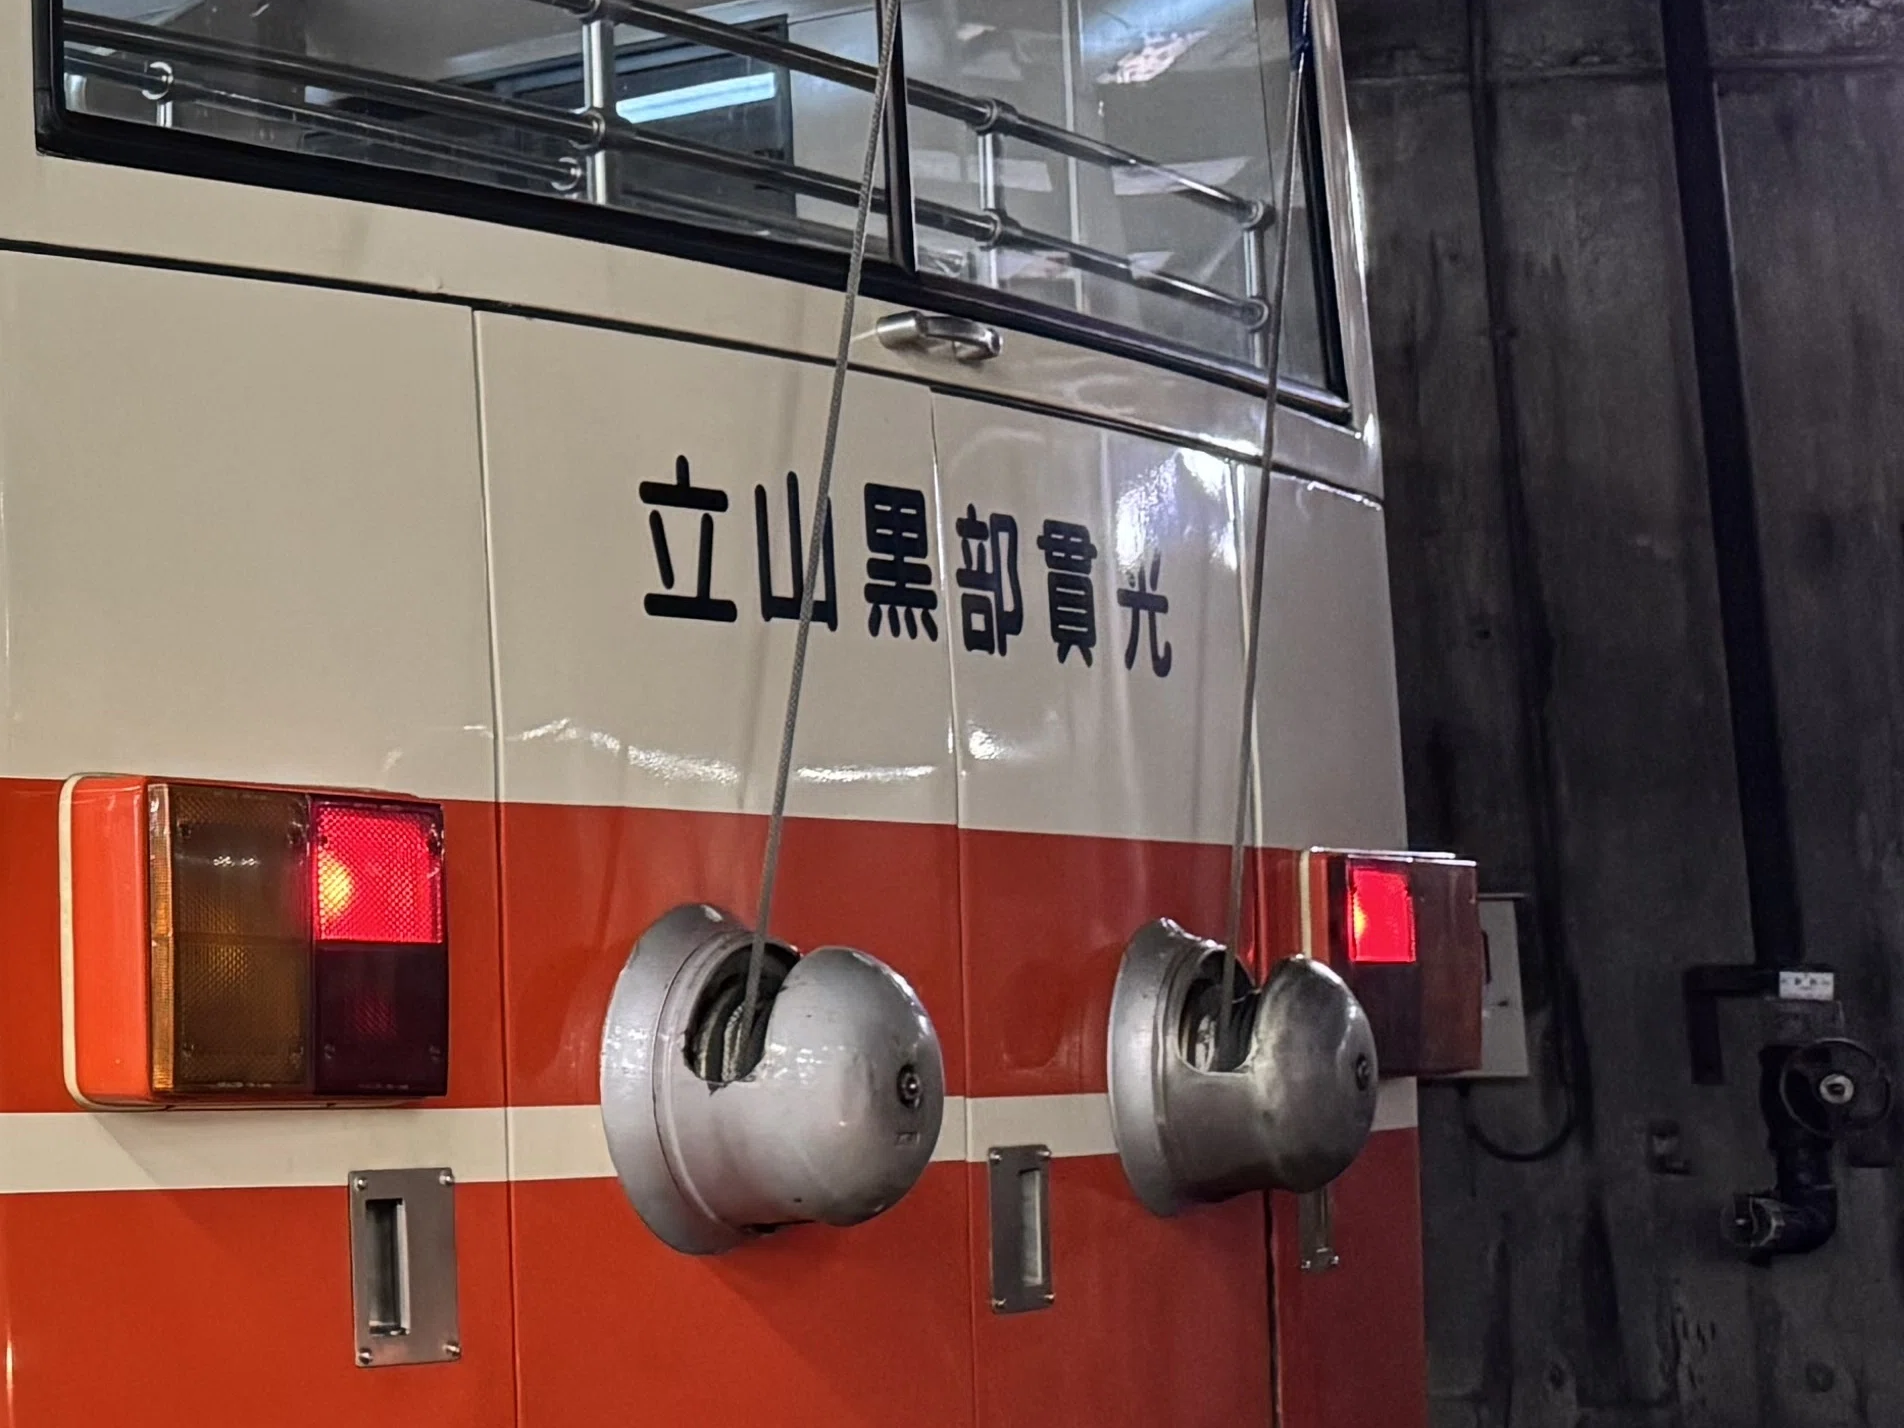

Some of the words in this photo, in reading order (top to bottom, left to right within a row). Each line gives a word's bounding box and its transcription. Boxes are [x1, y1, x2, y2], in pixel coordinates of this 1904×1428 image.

[638, 453, 1173, 678] 立山黒部貫光
